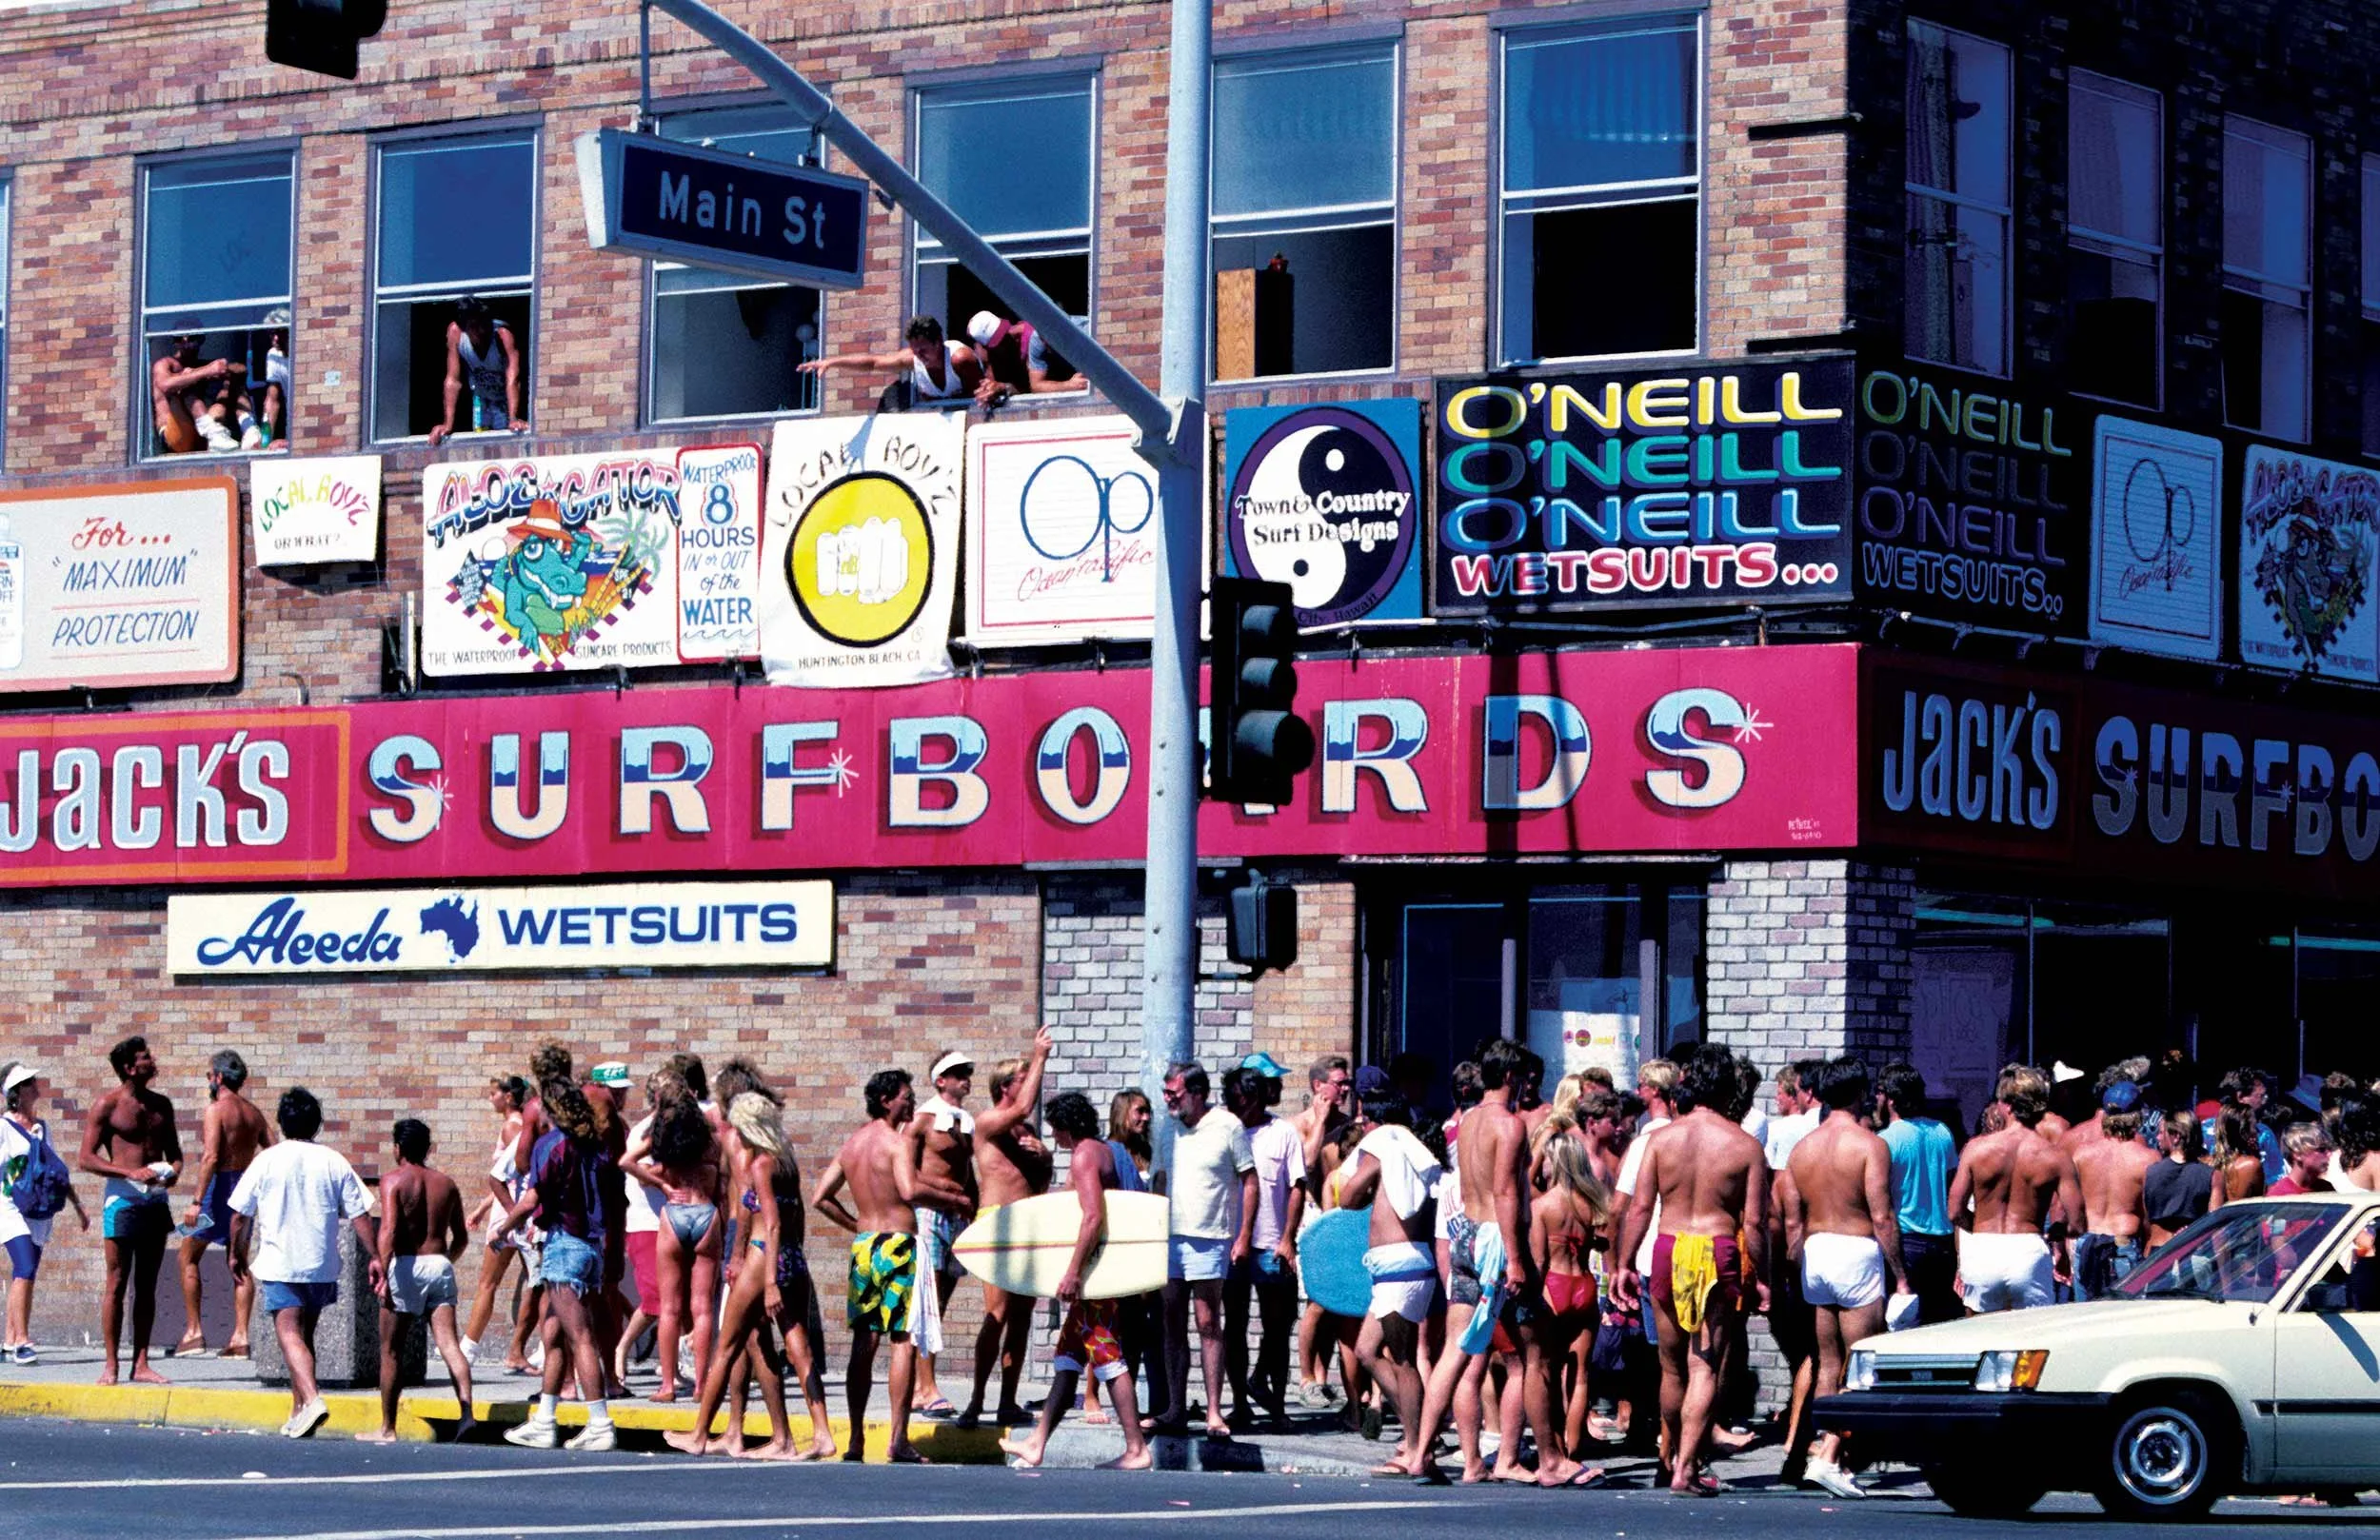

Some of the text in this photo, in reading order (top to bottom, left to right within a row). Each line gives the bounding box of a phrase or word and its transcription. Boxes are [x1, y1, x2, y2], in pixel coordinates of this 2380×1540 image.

[658, 170, 826, 249] Main St
[1445, 372, 1843, 439] O'NEILL
[1862, 369, 2073, 457] O'NEILL
[1443, 430, 1842, 494] O'NEILL
[1861, 428, 2069, 511] O'NEILL
[705, 484, 734, 524] 8
[1235, 487, 1412, 520] Town & Country
[1442, 488, 1841, 551] O'NEILL
[1859, 486, 2067, 566] O'NEILL
[682, 526, 756, 549] HOURS
[1252, 516, 1399, 553] Surf Designs
[684, 552, 704, 571] IN
[721, 550, 752, 570] OUT
[1451, 543, 1838, 598] WETSUITS...
[700, 573, 741, 596] of the
[51, 609, 201, 648] PROTECTION
[683, 597, 754, 627] WATER
[428, 651, 447, 666] THE
[452, 648, 517, 665] WATERPROOF
[623, 641, 673, 657] PRODUCTS
[798, 653, 866, 670] HUNTINGTON
[907, 648, 922, 662] CA
[368, 687, 1748, 845] SURFBORDS
[196, 896, 798, 966] Aleeda WETSUITS
